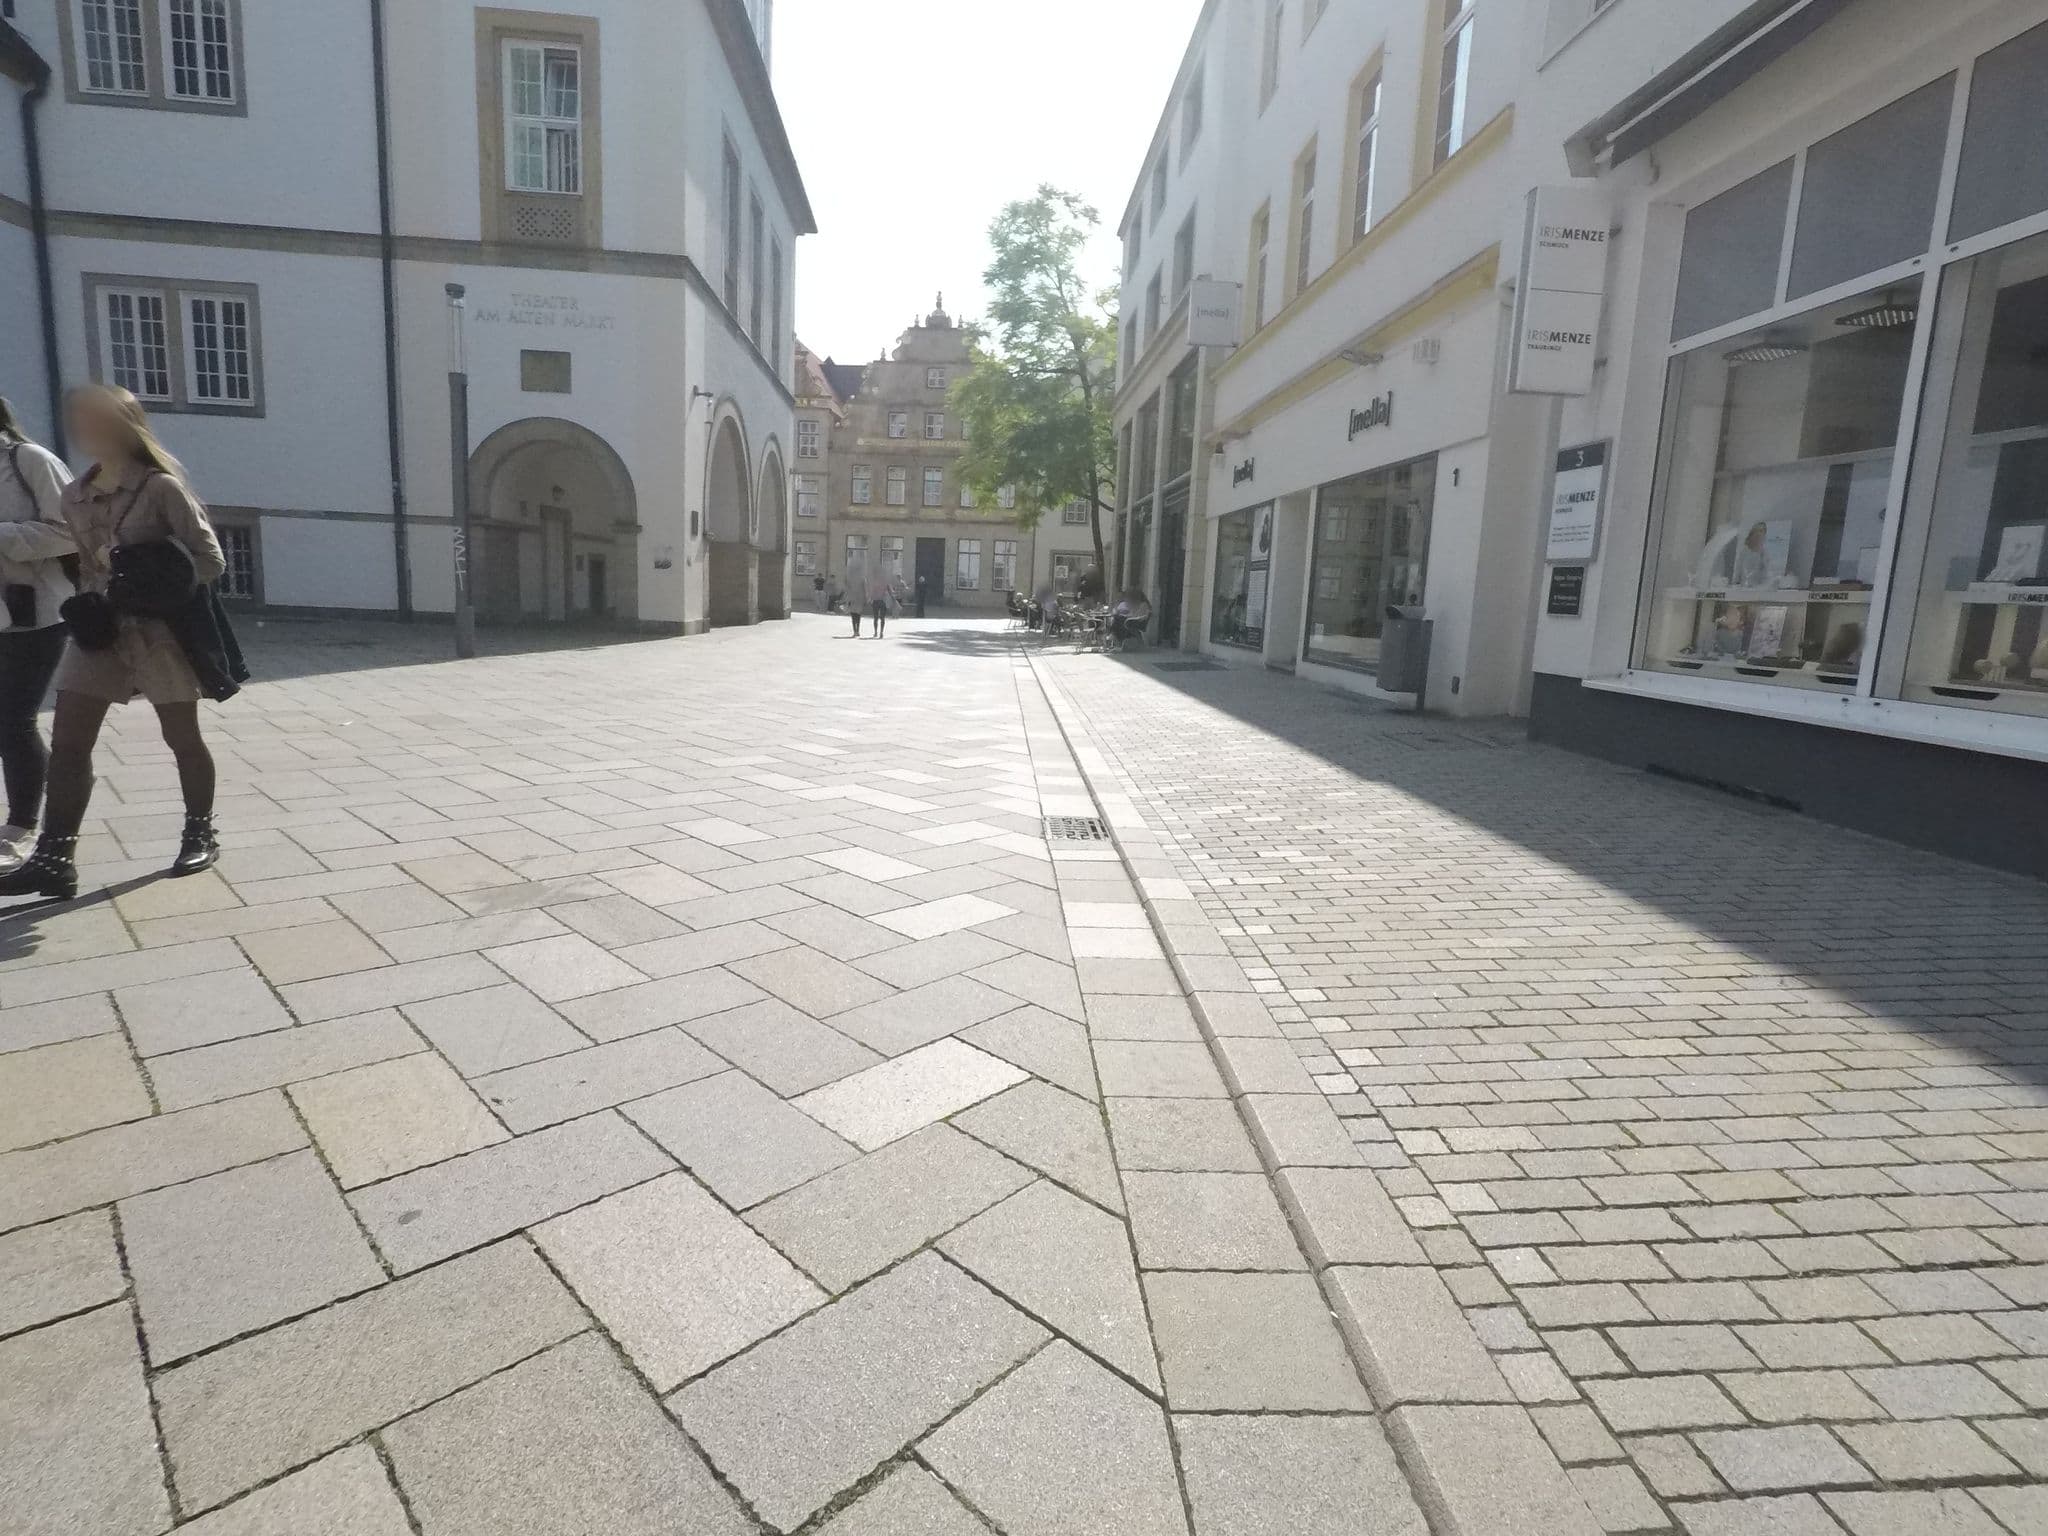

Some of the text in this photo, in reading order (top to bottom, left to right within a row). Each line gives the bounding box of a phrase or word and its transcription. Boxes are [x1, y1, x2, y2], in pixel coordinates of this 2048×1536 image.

[1540, 226, 1605, 242] IRISMENZE
[512, 293, 579, 310] THEATER
[475, 309, 616, 329] AM ALTEN MARKT
[1528, 329, 1592, 345] IRISMENZE
[1575, 450, 1585, 467] 3
